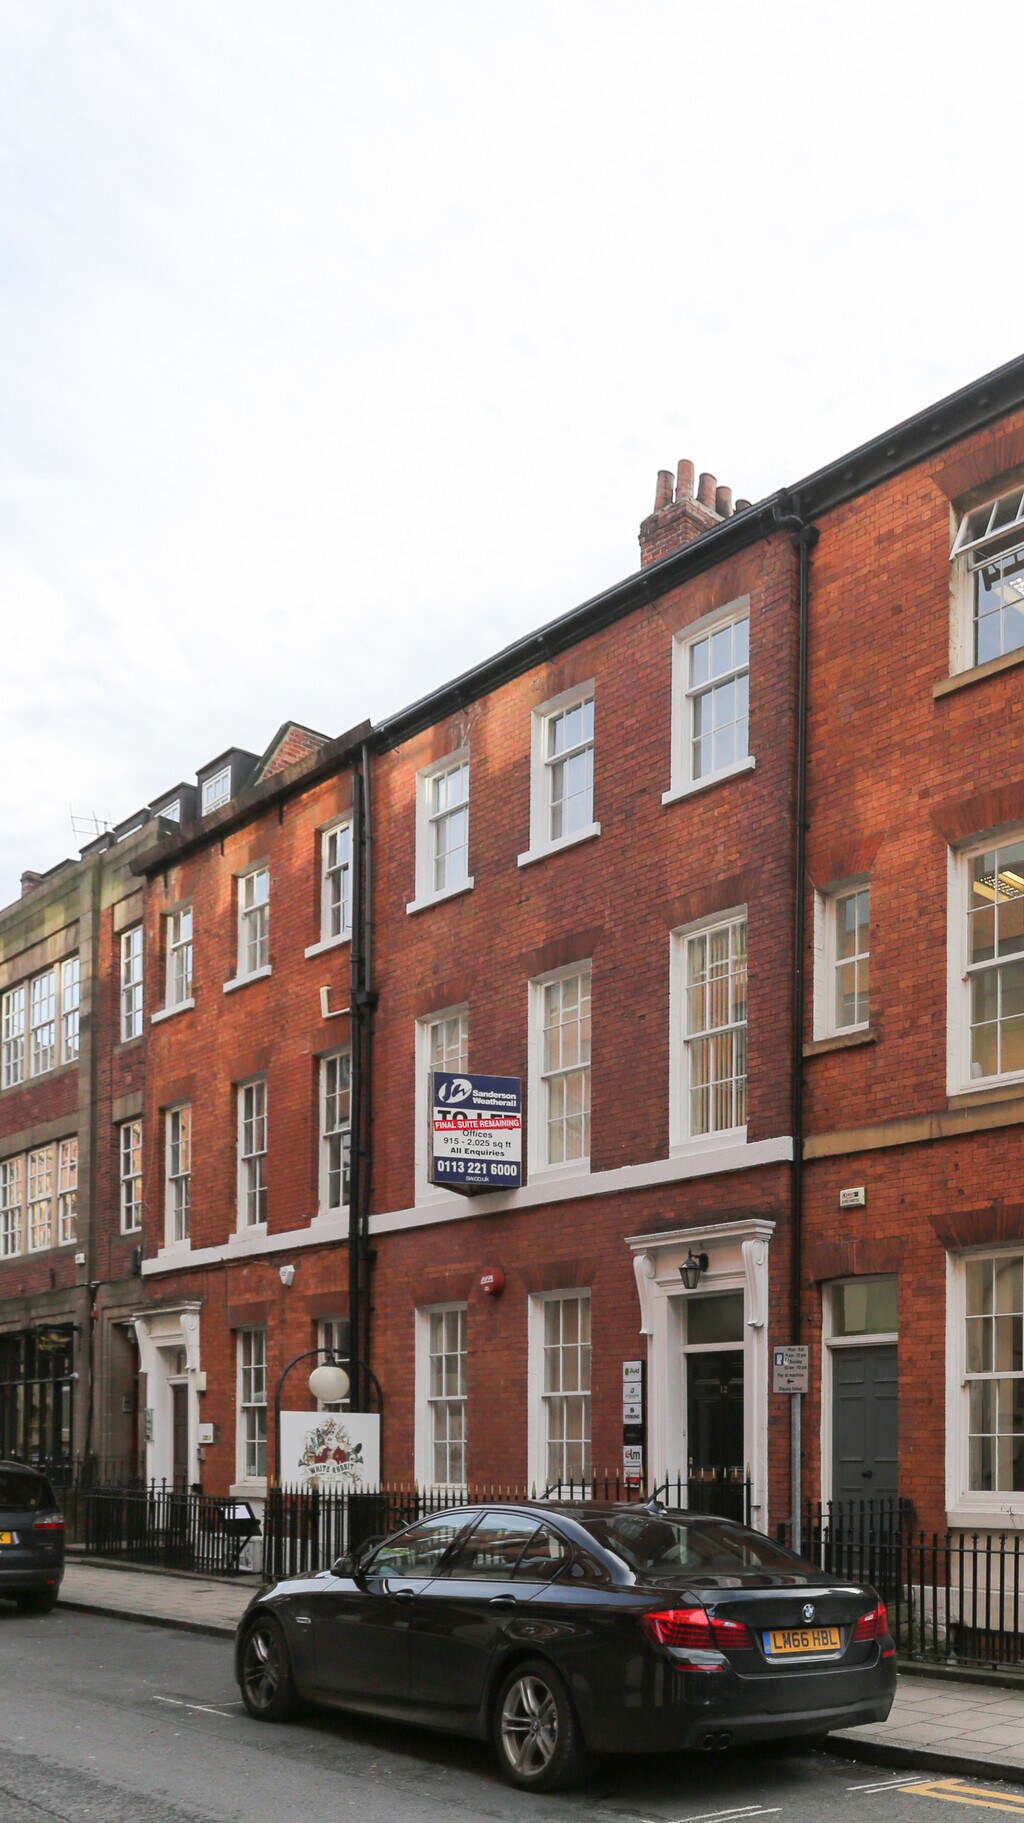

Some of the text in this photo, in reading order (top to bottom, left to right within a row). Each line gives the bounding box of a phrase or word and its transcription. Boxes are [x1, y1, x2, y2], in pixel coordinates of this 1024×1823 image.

[472, 1090, 516, 1099] Sanderson
[473, 1097, 516, 1107] Weatherall
[435, 1120, 519, 1129] FINAL SUITE REMAINING
[462, 1130, 493, 1138] Offices
[443, 1137, 459, 1145] 915
[467, 1138, 490, 1147] 2,025
[465, 1148, 505, 1157] Enquiries
[437, 1160, 517, 1176] 0113 221 6000
[309, 1462, 355, 1475] WHITE RABBIT
[772, 1628, 838, 1650] LM66 HBL
